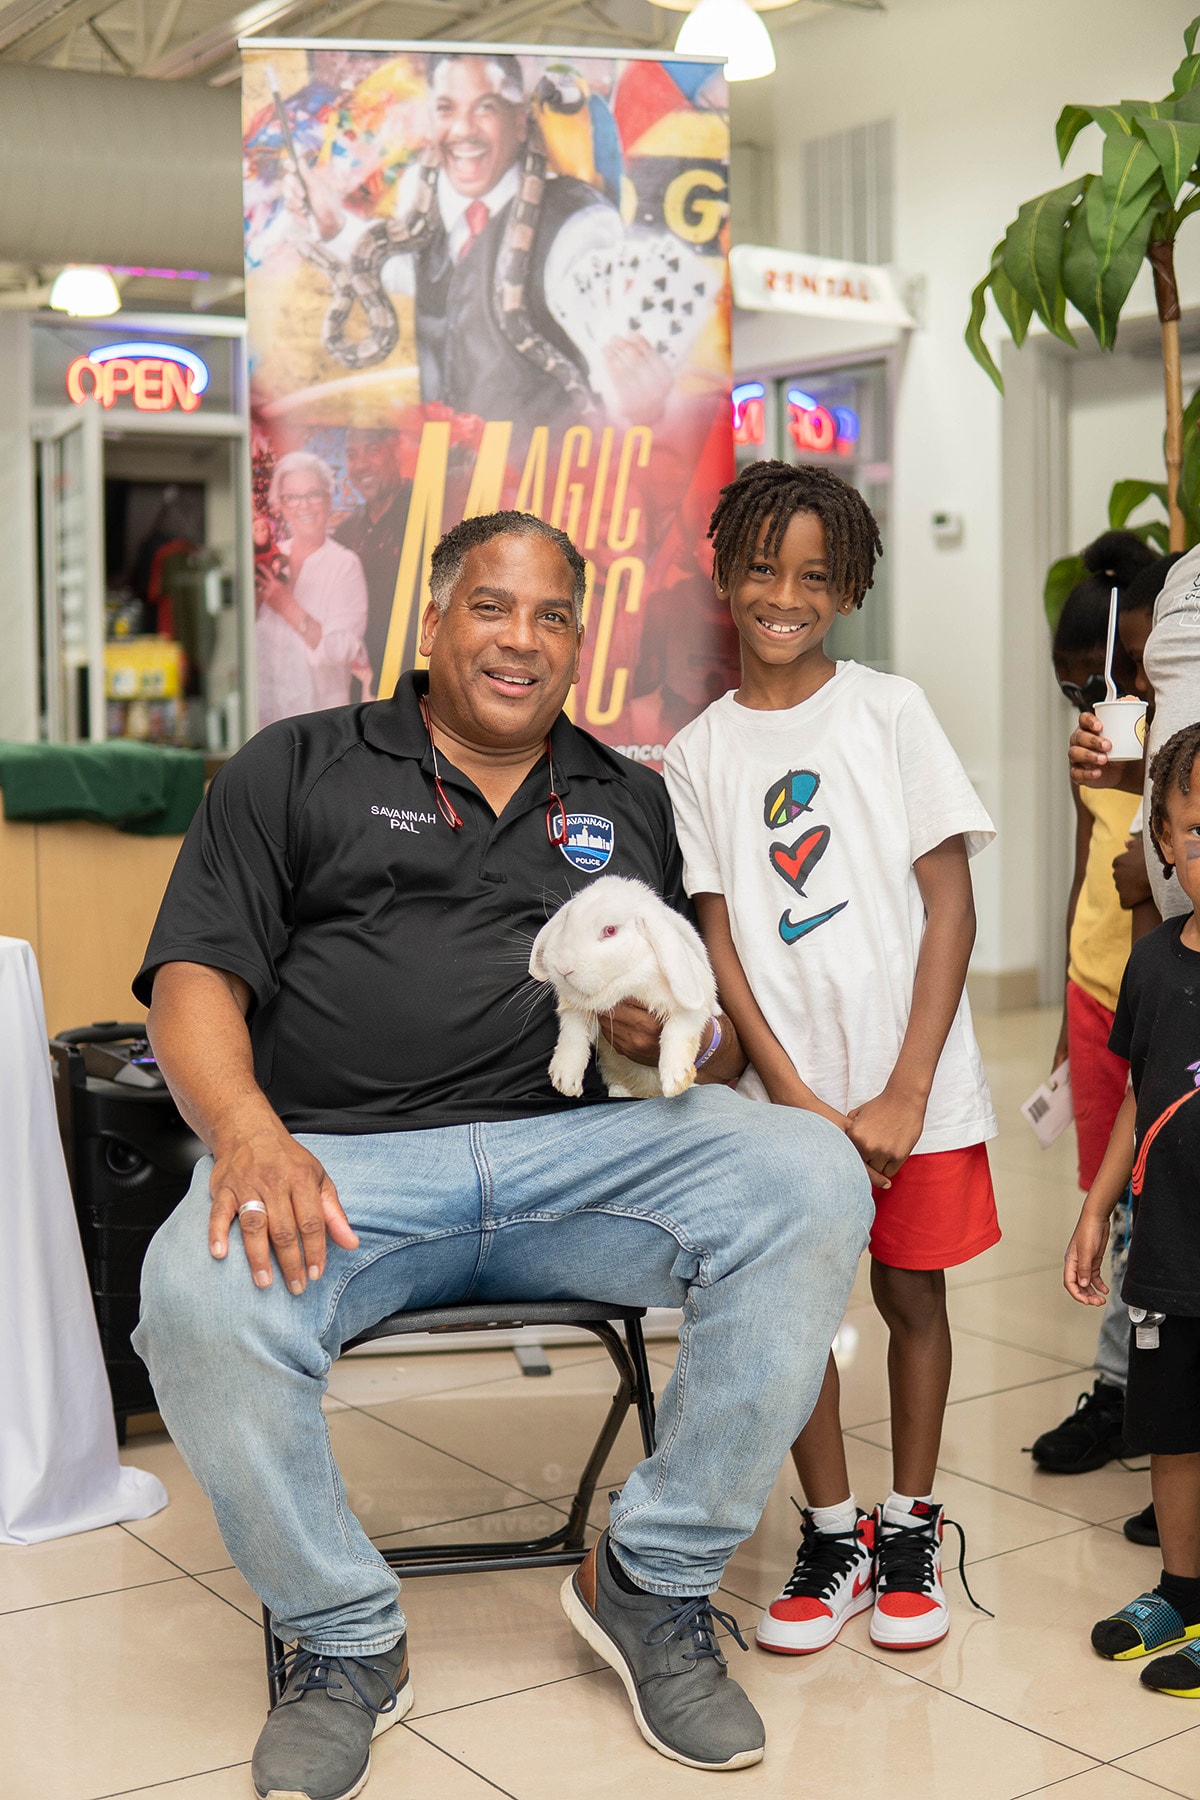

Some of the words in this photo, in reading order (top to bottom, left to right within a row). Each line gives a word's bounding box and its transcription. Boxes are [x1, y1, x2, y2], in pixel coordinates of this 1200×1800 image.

[763, 268, 871, 302] RENTAL
[66, 355, 201, 413] OPEN
[370, 805, 436, 824] SAVANNAH
[390, 818, 420, 834] PAL
[557, 816, 610, 831] SAVANNAH
[575, 857, 601, 867] POLICE
